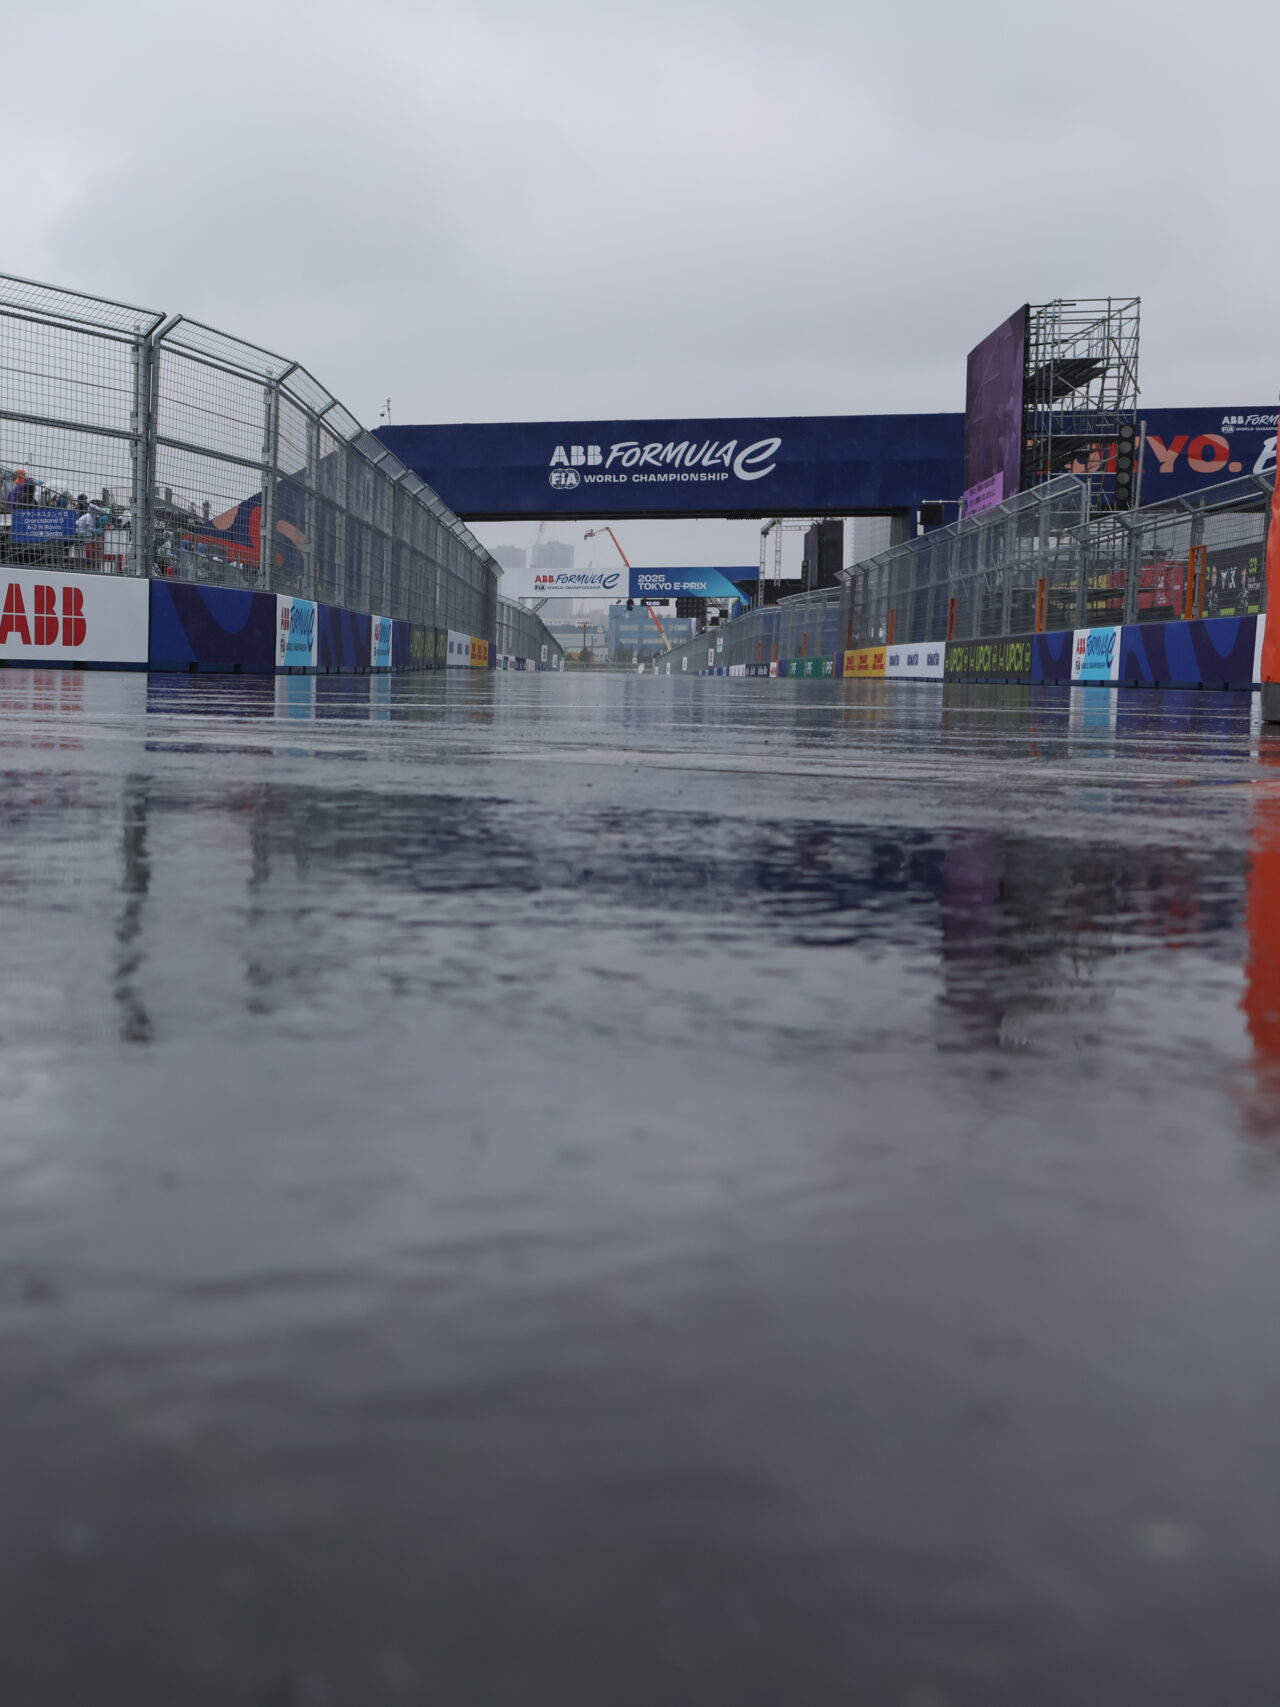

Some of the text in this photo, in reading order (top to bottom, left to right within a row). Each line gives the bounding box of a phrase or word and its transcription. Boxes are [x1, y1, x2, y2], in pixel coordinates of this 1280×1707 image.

[1221, 415, 1245, 425] ABB
[1222, 425, 1235, 433] FIA
[549, 445, 603, 467] ABB
[605, 439, 738, 469] FORMULA
[549, 470, 729, 487] FIA WORLD CHAMPIONSHIP
[534, 574, 555, 584] ABB
[555, 573, 603, 585] FORMULA
[637, 574, 666, 583] 2025
[534, 584, 545, 592] FIA
[638, 582, 708, 591] TOKYO E-PRIX
[280, 606, 290, 631] ABB
[1076, 637, 1086, 655] ABB
[1006, 643, 1025, 672] UPCX
